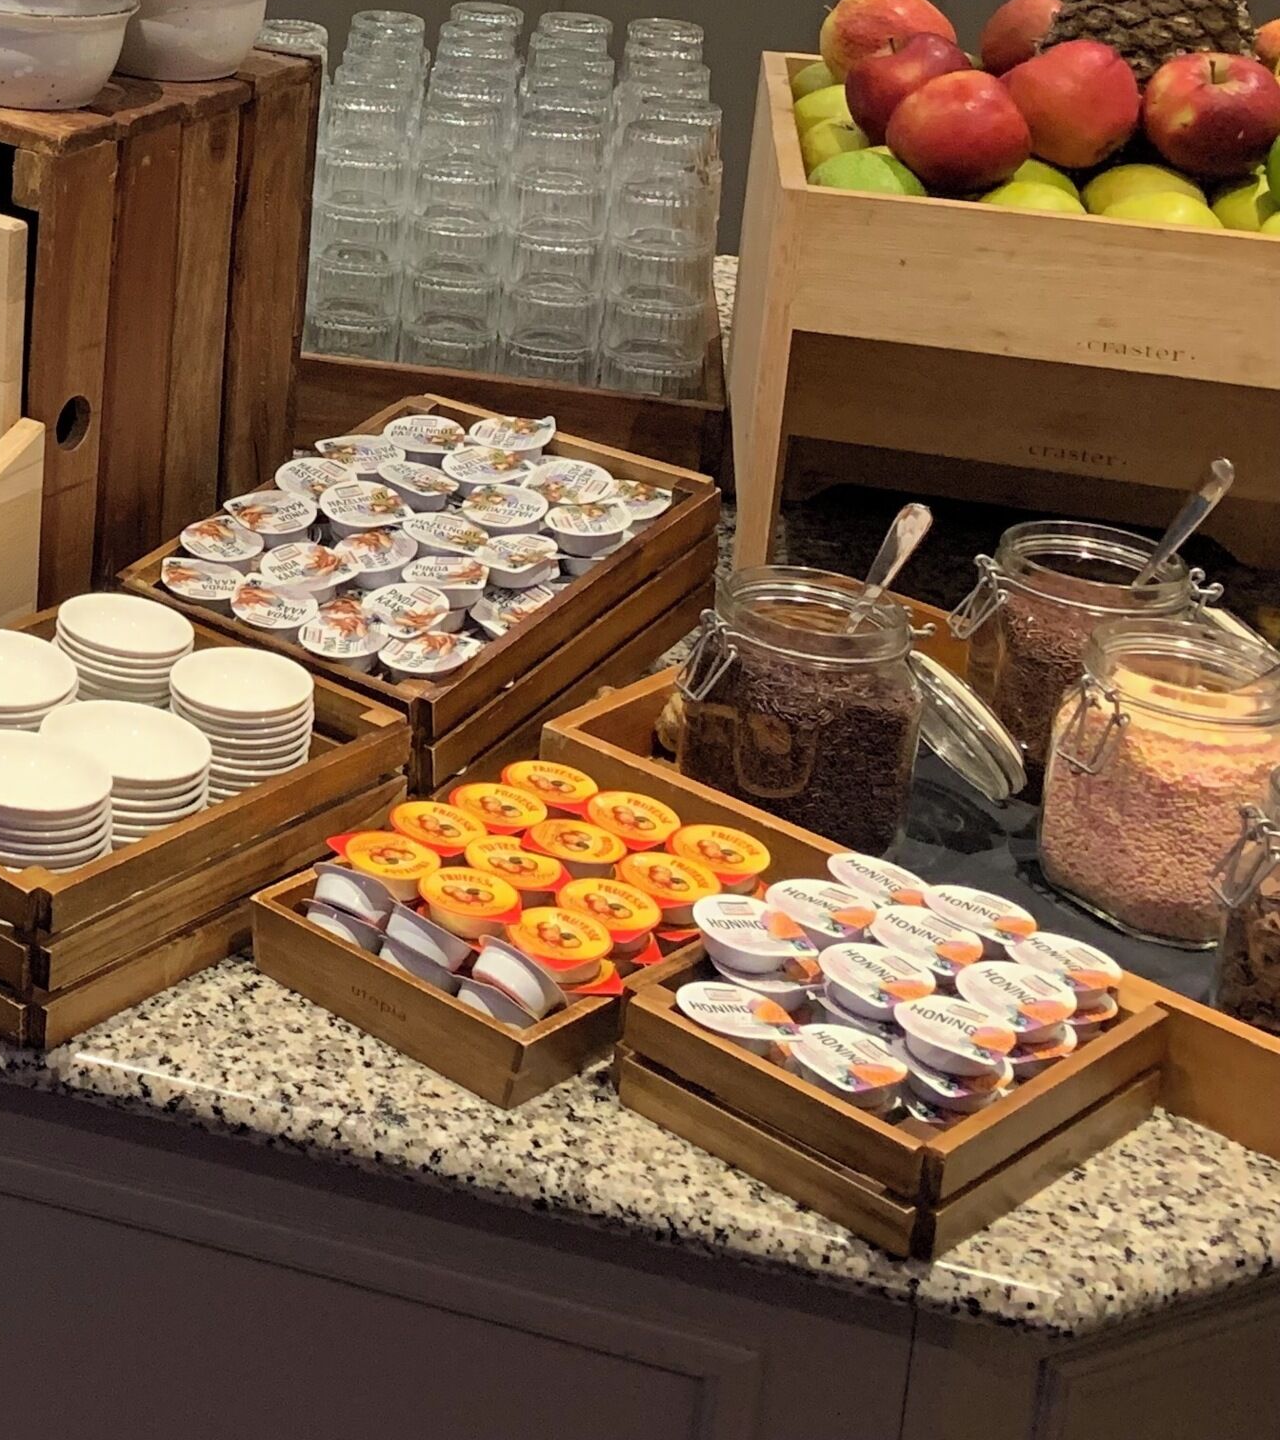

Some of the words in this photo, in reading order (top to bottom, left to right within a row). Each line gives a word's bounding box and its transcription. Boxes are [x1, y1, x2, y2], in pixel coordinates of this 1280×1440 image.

[327, 490, 386, 506] HAZELNOOT
[268, 559, 300, 573] PINDA
[276, 568, 304, 582] KAAS
[376, 594, 403, 612] KAAS
[386, 589, 417, 607] PINDA
[848, 858, 902, 894] HONING
[783, 887, 840, 912] HONING
[940, 892, 1000, 921] HONING
[706, 918, 764, 930] HONING
[884, 913, 946, 946] HONING
[843, 948, 897, 984] HONING
[981, 968, 1036, 1005] HONING
[910, 1003, 977, 1036] HONING
[812, 1030, 868, 1065] HONING
